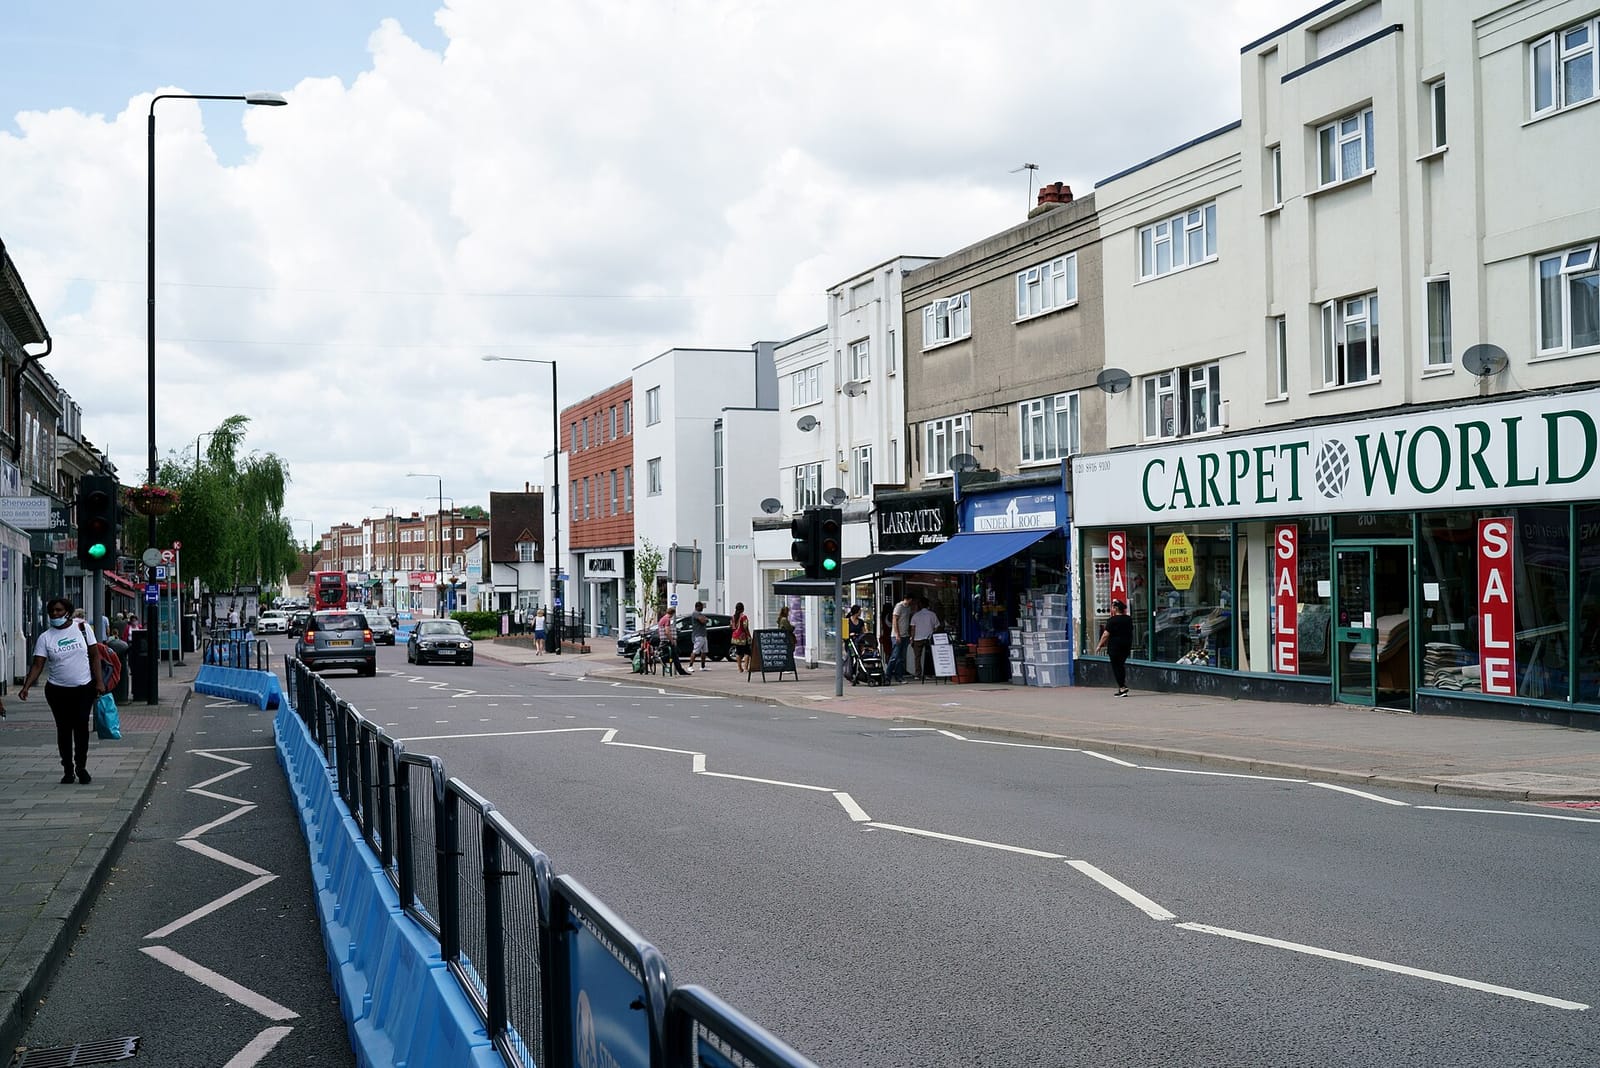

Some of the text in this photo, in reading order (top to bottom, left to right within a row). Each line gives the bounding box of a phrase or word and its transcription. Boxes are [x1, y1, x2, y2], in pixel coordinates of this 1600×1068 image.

[1142, 409, 1598, 512] CARPET WORLD
[1, 499, 46, 507] Sherwoods
[50, 511, 60, 519] ot
[980, 517, 1008, 529] UNDER
[1018, 514, 1041, 528] ROOF
[1171, 535, 1185, 545] FREE
[1110, 535, 1125, 593] SA
[1277, 529, 1295, 672] SALE
[1481, 522, 1512, 693] SALE
[53, 642, 83, 653] LACOSTE
